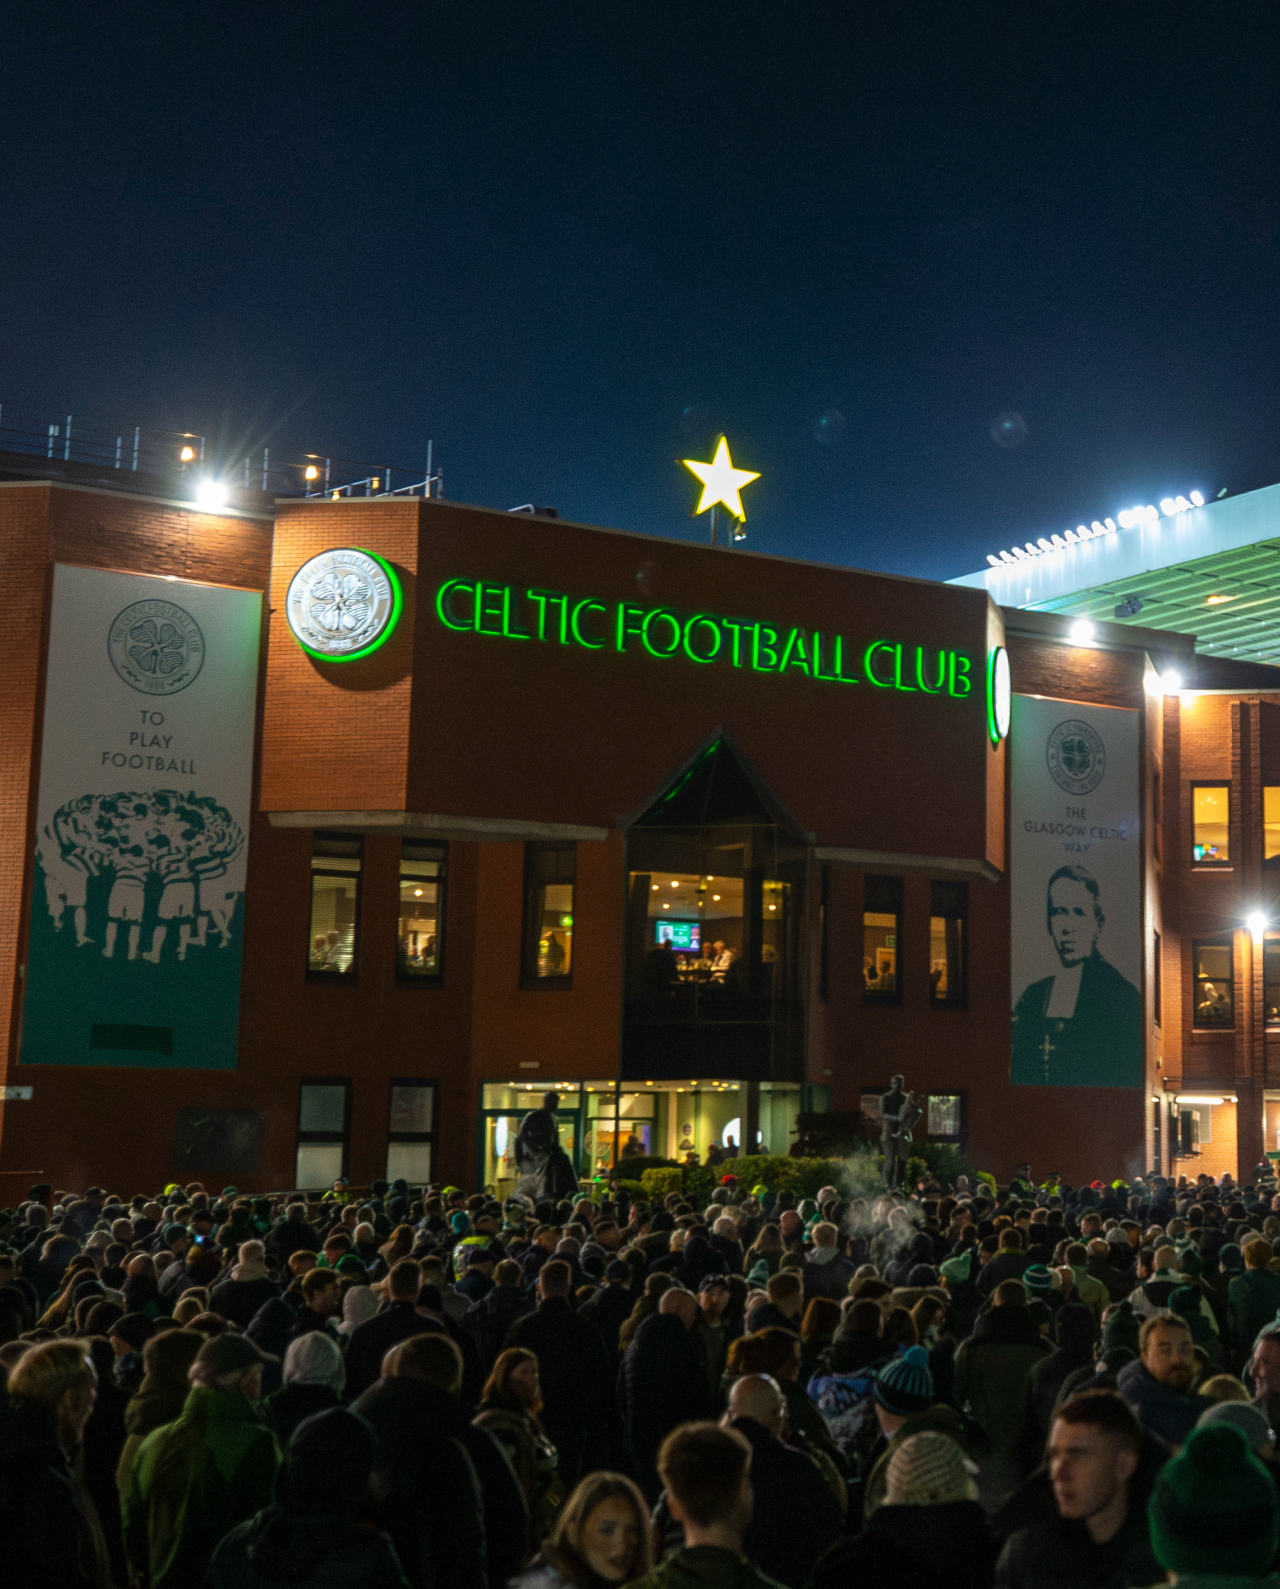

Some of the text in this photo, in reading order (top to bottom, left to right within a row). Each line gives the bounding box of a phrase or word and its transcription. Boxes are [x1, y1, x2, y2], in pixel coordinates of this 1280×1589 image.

[435, 578, 972, 699] CELTIC FOOTBALL CLUB
[139, 709, 165, 726] TO
[129, 731, 173, 749] PLAY
[101, 751, 197, 775] FOOTBALL
[1066, 807, 1086, 819] THE
[1024, 821, 1126, 841] GLASGOW CELTIC
[1063, 842, 1090, 854] WAY
